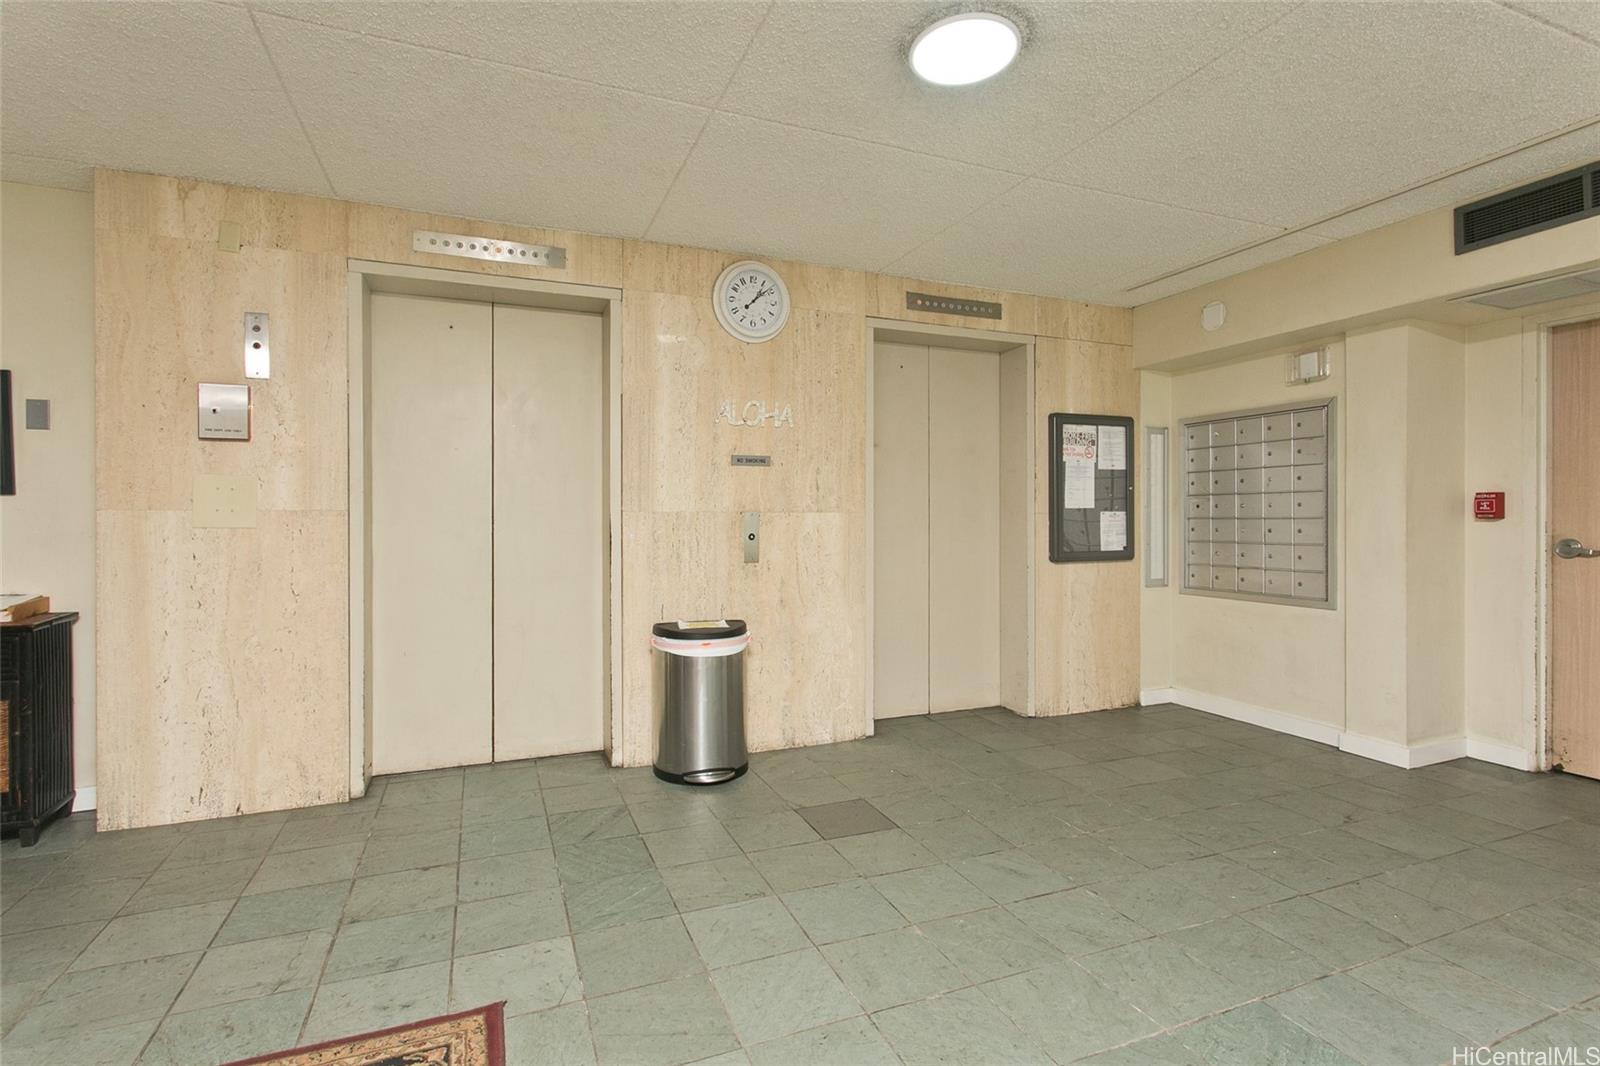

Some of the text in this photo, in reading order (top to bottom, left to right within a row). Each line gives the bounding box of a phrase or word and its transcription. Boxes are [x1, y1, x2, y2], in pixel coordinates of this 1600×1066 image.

[749, 275, 758, 285] 12
[714, 399, 794, 428] ALOHA
[745, 457, 767, 465] SMOKING
